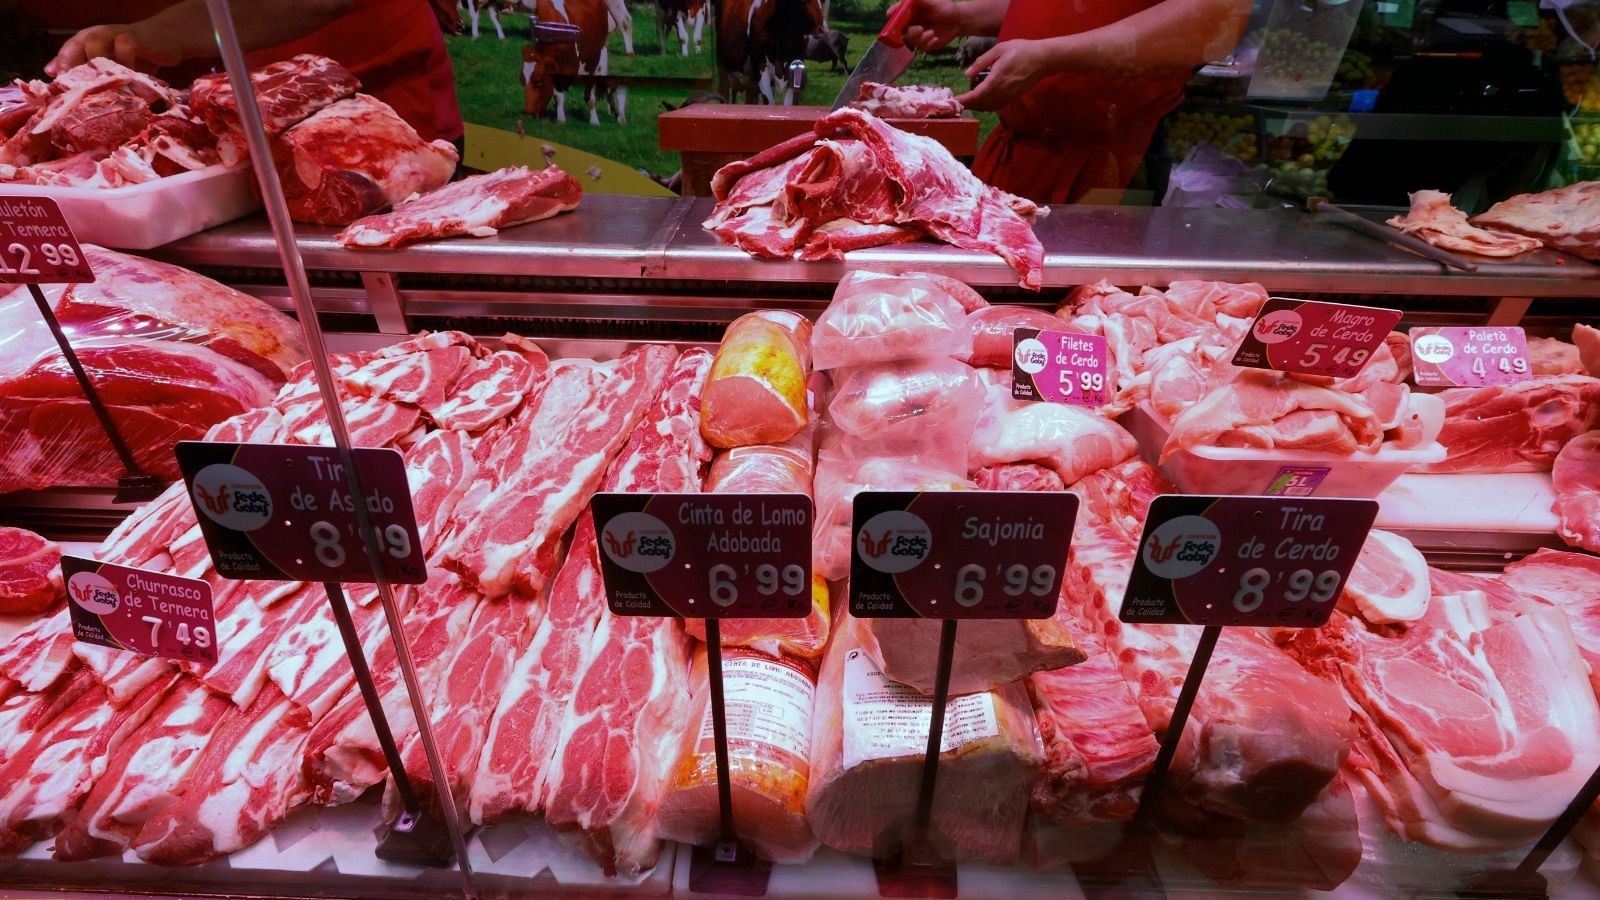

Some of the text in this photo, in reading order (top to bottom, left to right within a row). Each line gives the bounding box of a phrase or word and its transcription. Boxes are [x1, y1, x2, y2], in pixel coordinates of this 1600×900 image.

[0, 200, 48, 217] uletón
[2, 221, 68, 237] Ternera
[1329, 310, 1375, 328] Magro
[1310, 324, 1374, 342] de Cerdo
[1062, 336, 1093, 351] Filetes
[1464, 344, 1517, 353] de Cerdo
[1056, 352, 1098, 367] de Cerdo
[1299, 343, 1369, 367] 5'49
[1473, 357, 1527, 378] 4'49
[1060, 370, 1103, 395] 5'99
[307, 455, 346, 481] Tir
[234, 490, 265, 502] Fede
[290, 486, 394, 513] de Asdo
[678, 502, 806, 526] Cinta de Lomo
[1281, 507, 1325, 532] Tira
[962, 516, 1044, 547] Sajonia
[640, 536, 670, 547] Fede
[707, 530, 781, 553] Adobada
[896, 536, 927, 547] Fede
[1183, 541, 1215, 552] Fede
[1238, 536, 1340, 560] de Cerdo
[126, 574, 201, 600] Churrasco
[708, 563, 804, 607] 6'99
[954, 563, 1056, 607] 6'99
[1233, 568, 1341, 613] 8'99
[616, 591, 647, 599] Producto
[859, 592, 891, 600] Producto
[1132, 598, 1164, 606] Producto
[125, 591, 209, 620] de Ternera
[856, 602, 864, 610] de
[1126, 608, 1136, 616] de
[142, 616, 210, 648] 7'49
